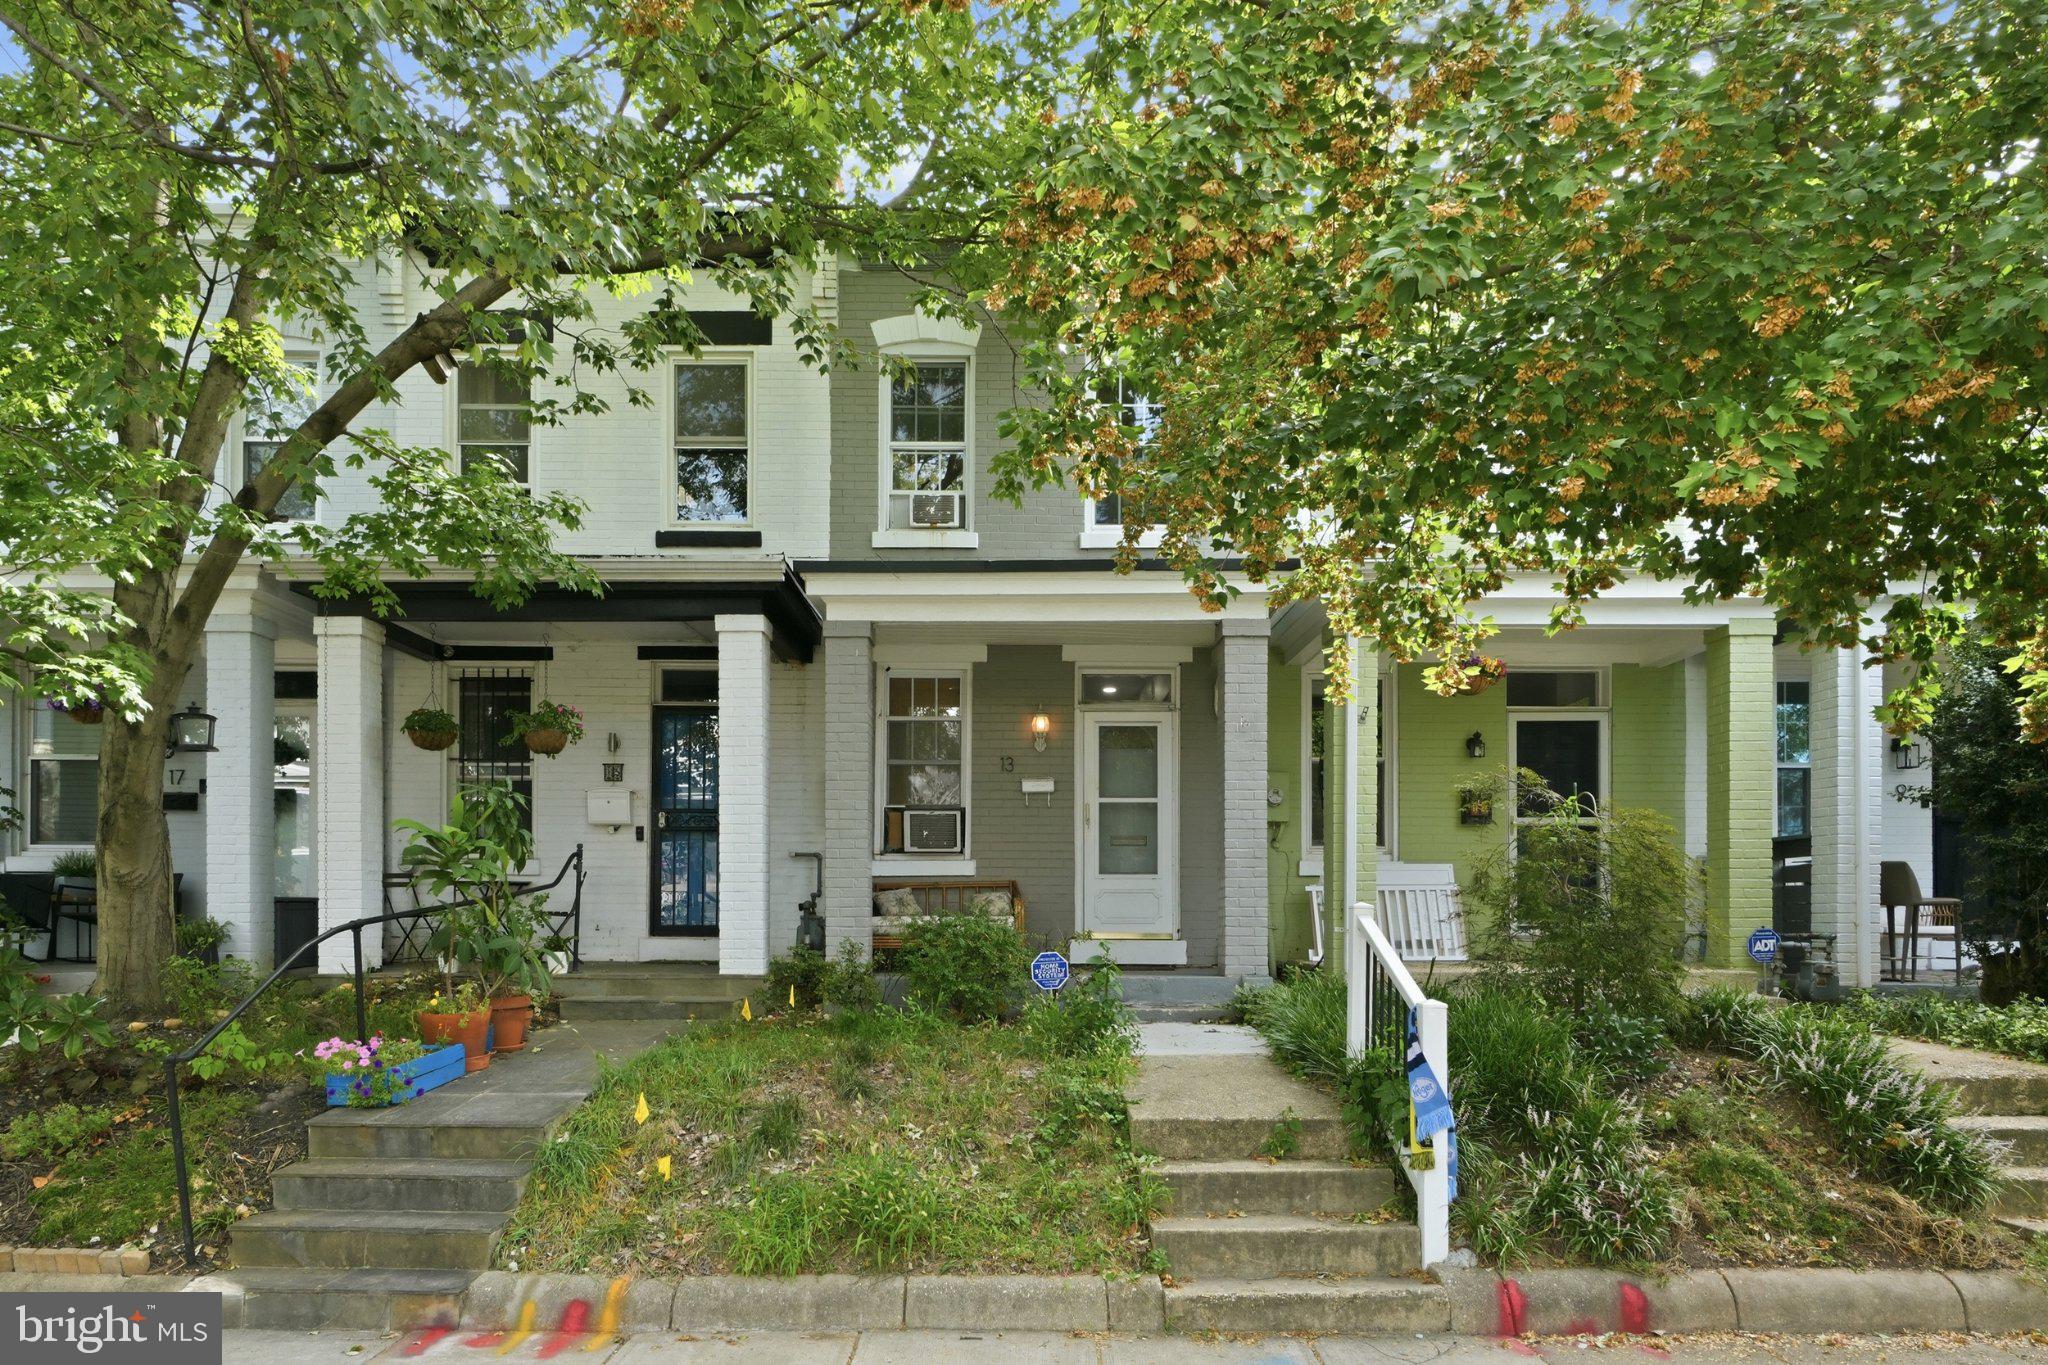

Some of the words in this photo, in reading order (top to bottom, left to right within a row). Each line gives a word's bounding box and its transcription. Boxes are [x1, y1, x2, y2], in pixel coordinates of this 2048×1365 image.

[1000, 756, 1015, 772] 13
[168, 769, 186, 785] 17
[1754, 939, 1776, 952] ADT
[1034, 967, 1066, 975] SECURITY
[1040, 962, 1059, 970] HOME
